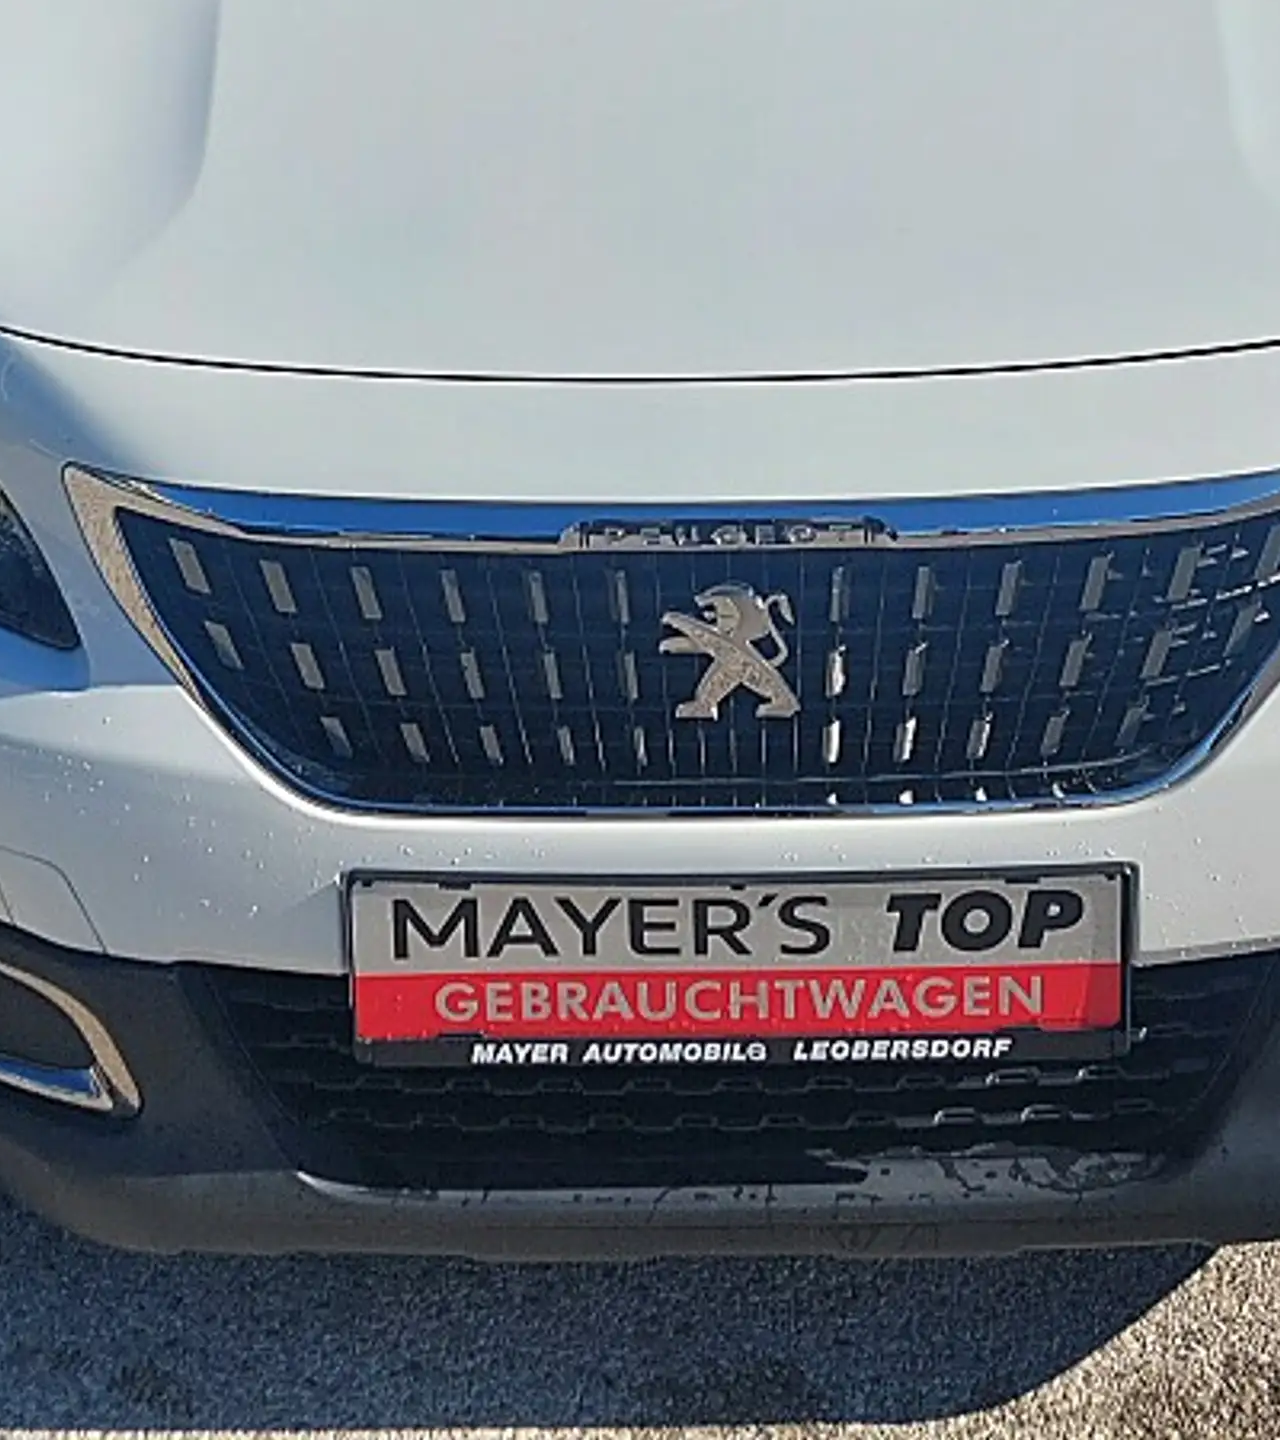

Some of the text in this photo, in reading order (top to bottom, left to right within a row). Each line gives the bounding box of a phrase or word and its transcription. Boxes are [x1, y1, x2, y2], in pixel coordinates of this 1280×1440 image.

[883, 888, 1088, 954] TOP
[433, 976, 1046, 1024] GEBRAUCHTWAGEN
[470, 1040, 570, 1065] MAYER
[793, 1037, 1014, 1062] LEOBERSDORF
